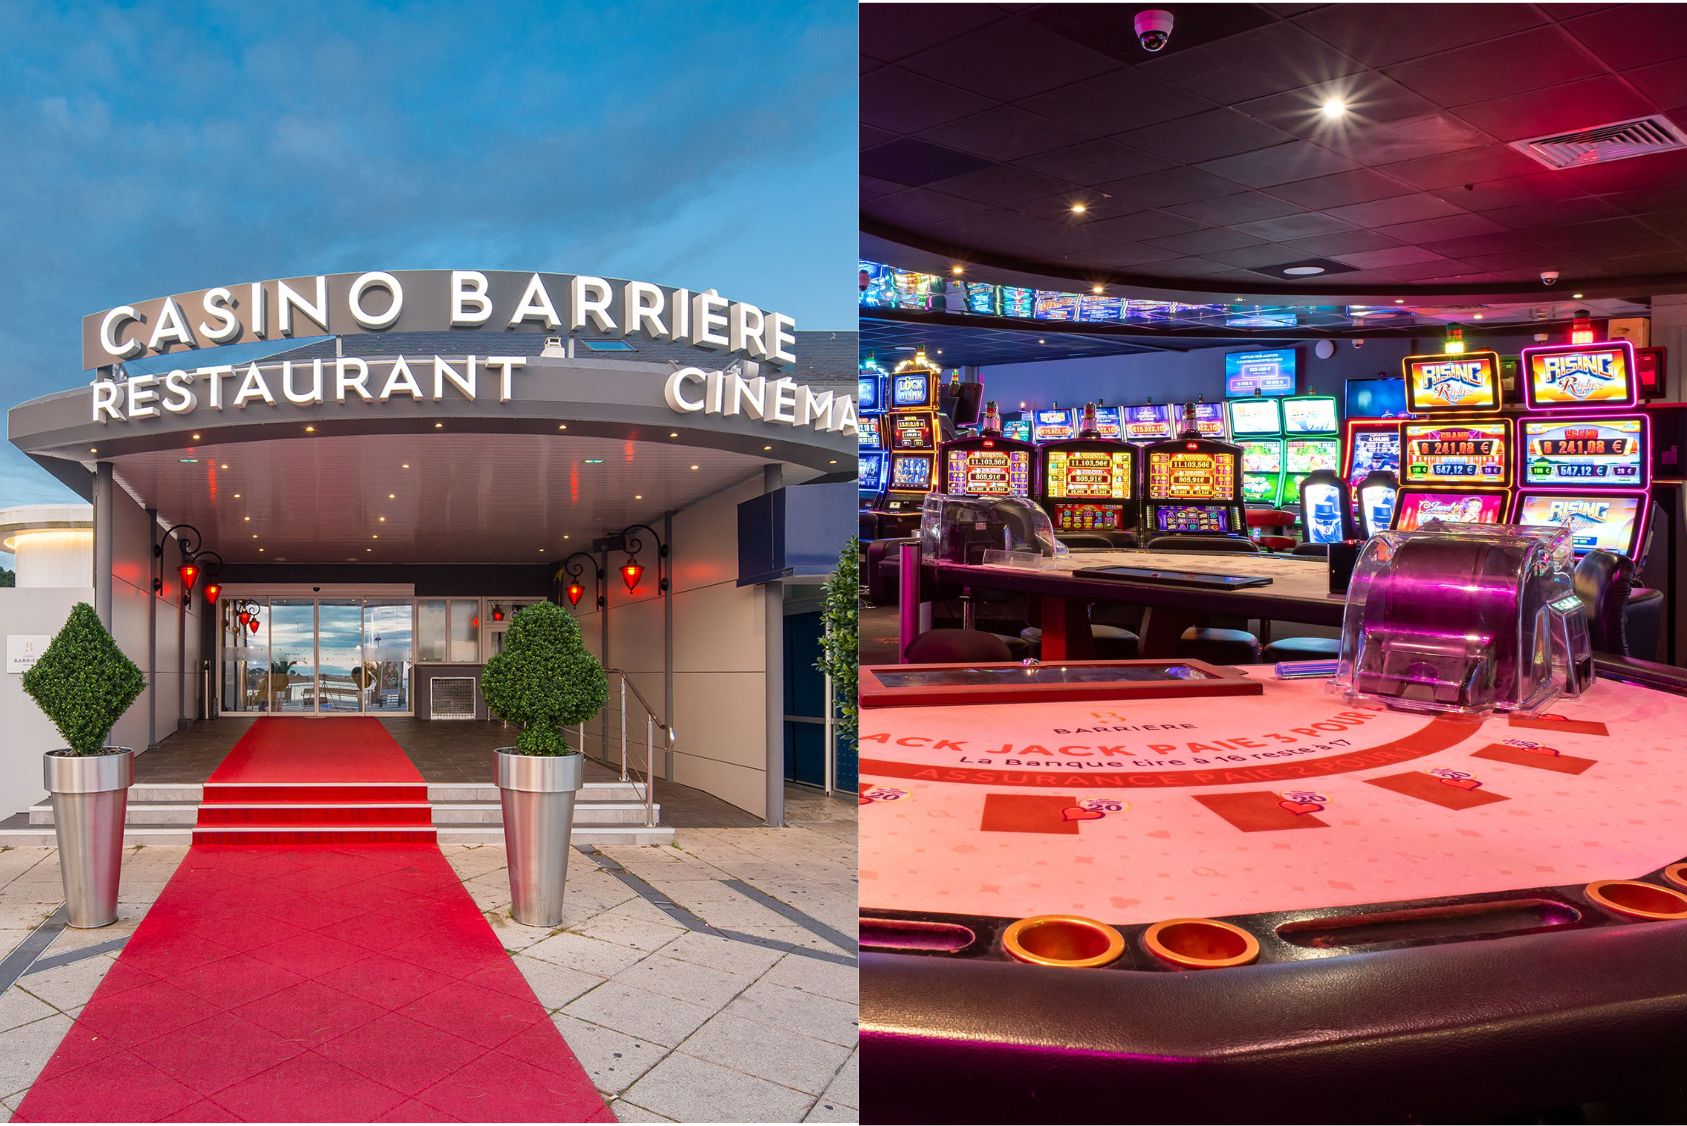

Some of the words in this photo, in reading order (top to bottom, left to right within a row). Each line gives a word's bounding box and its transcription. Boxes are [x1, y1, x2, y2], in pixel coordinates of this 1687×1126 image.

[101, 271, 403, 357] CASINO
[451, 271, 796, 363] BARRIÈRE
[1421, 362, 1483, 389] RISING
[1543, 353, 1614, 383] RISING
[93, 355, 526, 423] RESTAURANT
[665, 367, 858, 436] CINÉMA
[1480, 441, 1490, 454] €
[1612, 439, 1622, 453] €
[1548, 501, 1610, 523] RISING
[985, 744, 1136, 757] JACK
[1148, 737, 1268, 755] PAIE
[1262, 733, 1298, 743] 3
[1290, 710, 1377, 737] POUR
[913, 768, 1185, 786] ASSURANCE
[1194, 768, 1281, 783] PAIE
[1287, 766, 1311, 775] 2
[1314, 750, 1406, 772] POUR
[960, 756, 992, 765] La
[1005, 758, 1123, 769] Banque
[1133, 758, 1186, 767] tire
[1192, 756, 1210, 765] à
[1214, 754, 1246, 763] 16
[1251, 746, 1315, 760] reste
[1312, 743, 1330, 751] à
[1329, 738, 1352, 748] 17
[865, 791, 900, 801] 20
[1293, 795, 1327, 803] 20
